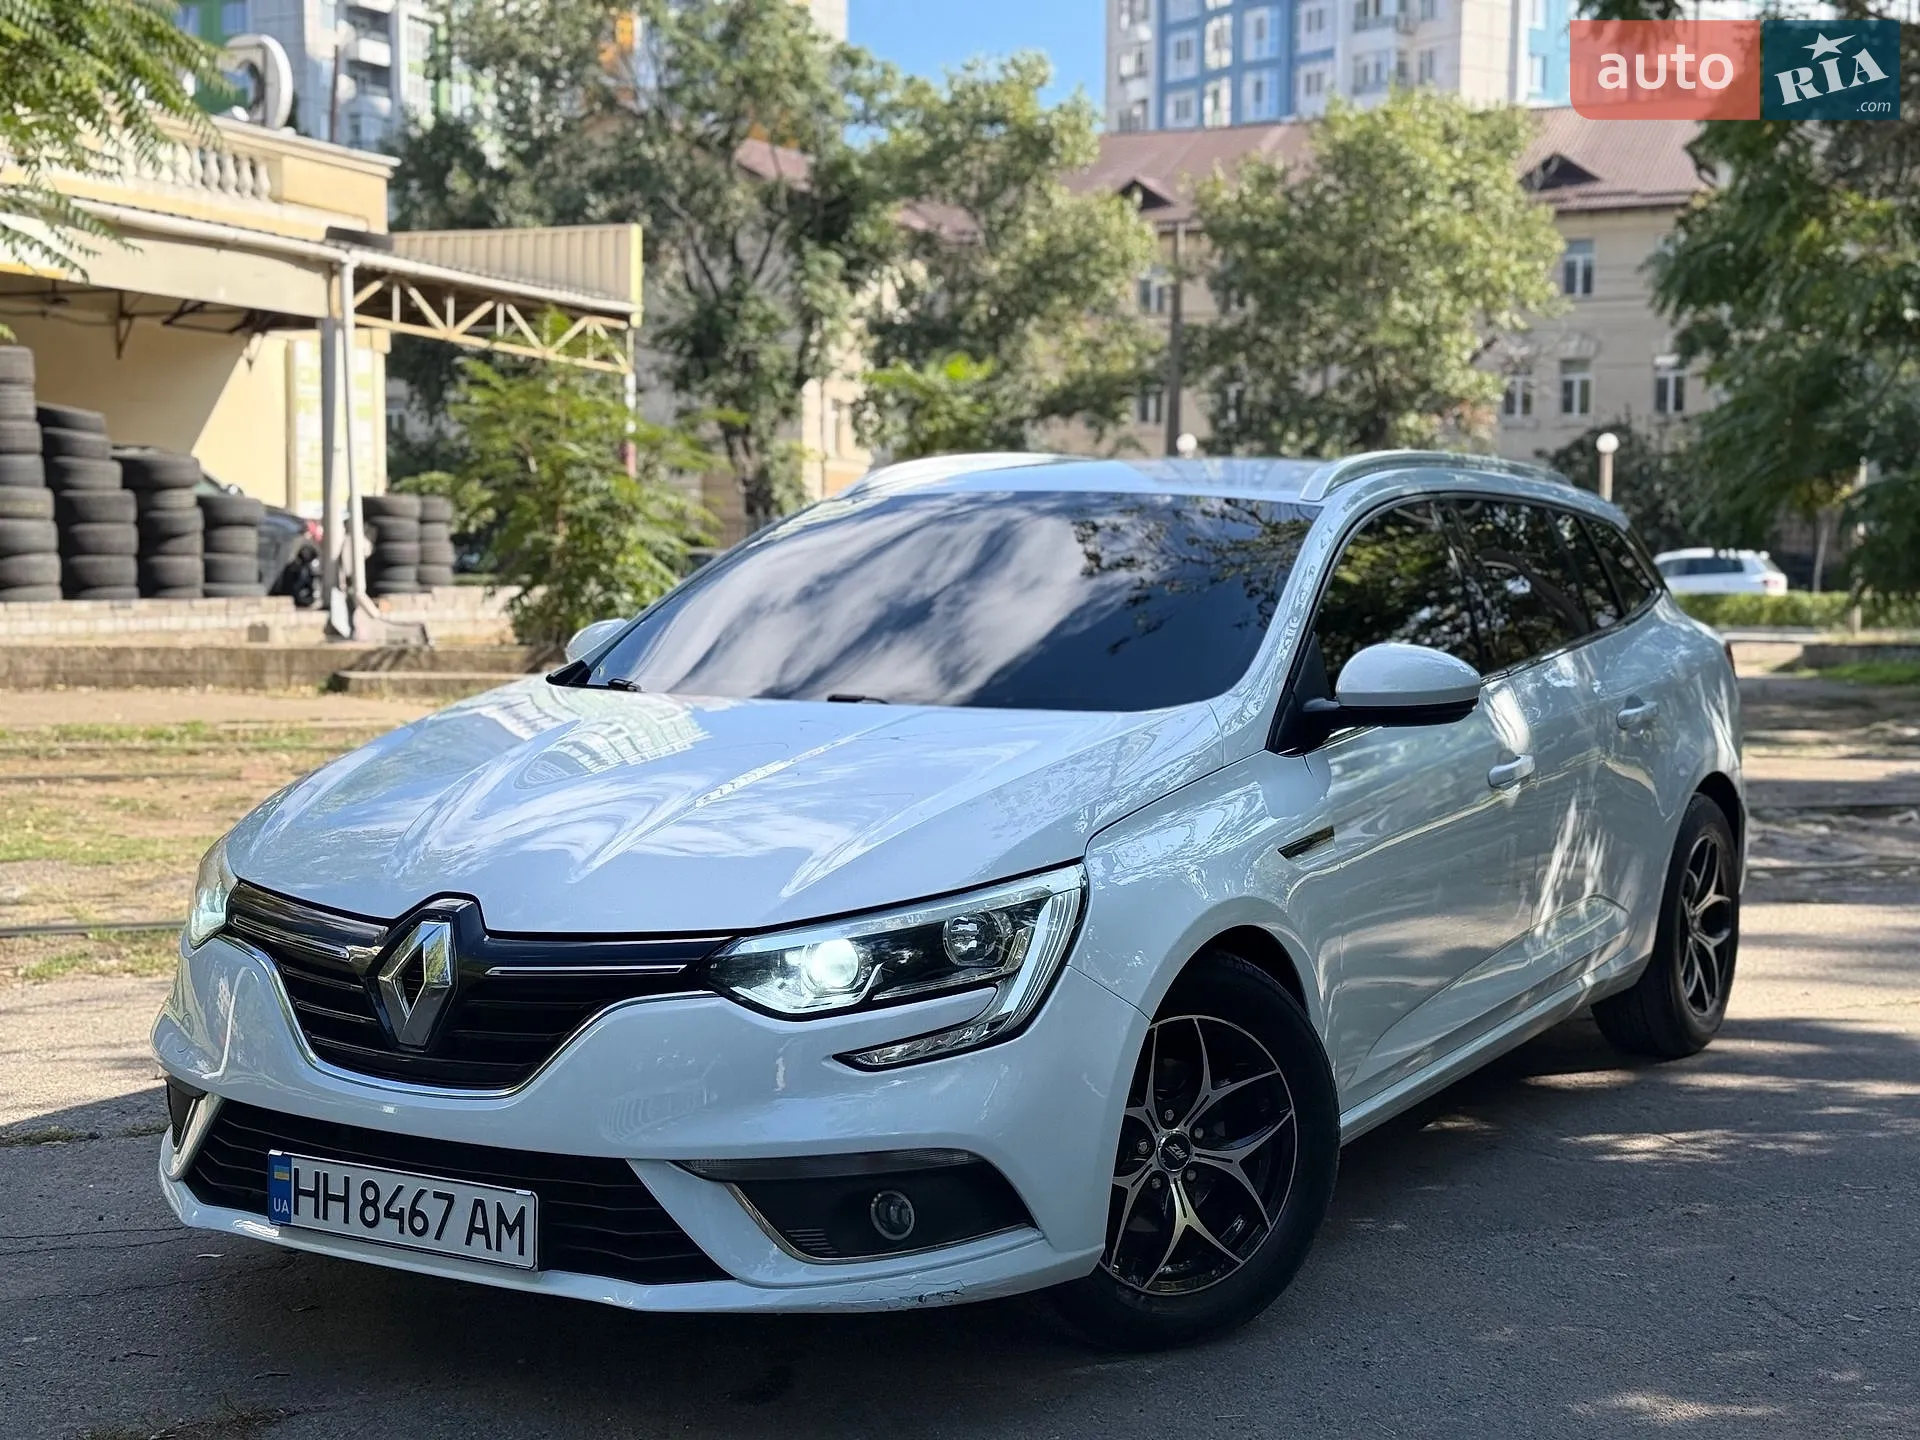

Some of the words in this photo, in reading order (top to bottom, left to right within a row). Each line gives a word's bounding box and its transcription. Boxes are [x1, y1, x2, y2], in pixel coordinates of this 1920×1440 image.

[273, 1197, 290, 1215] UA
[293, 1167, 350, 1225] HH
[359, 1178, 455, 1241] 8467
[465, 1198, 526, 1257] AM
